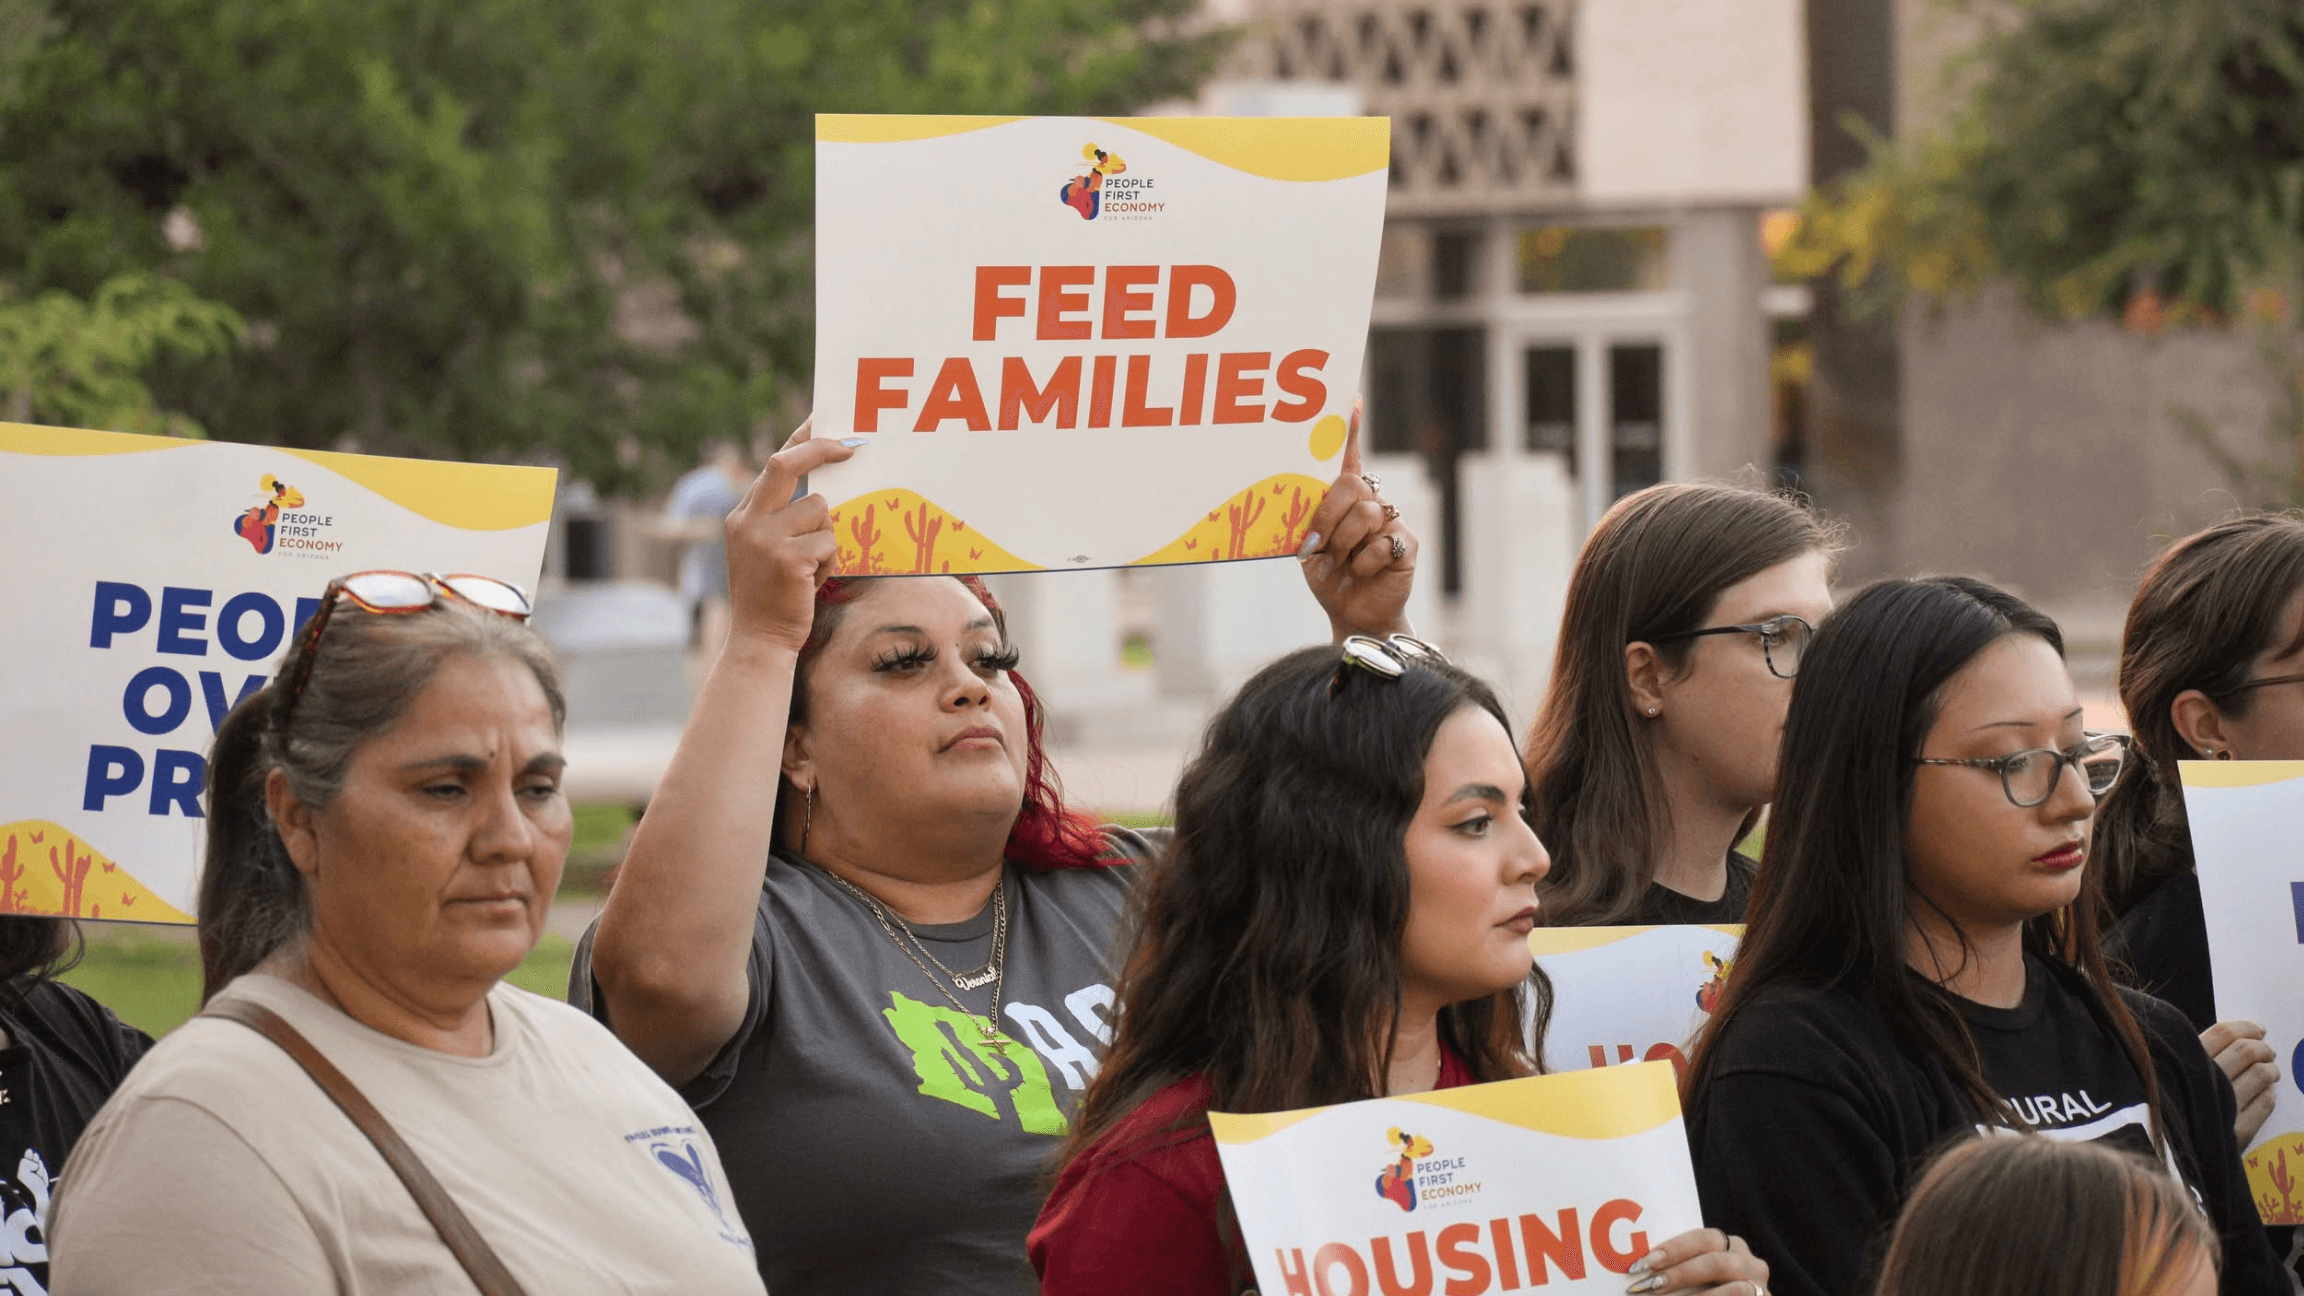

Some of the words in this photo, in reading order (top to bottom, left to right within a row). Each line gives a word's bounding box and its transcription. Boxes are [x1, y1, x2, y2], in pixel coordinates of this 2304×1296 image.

[1106, 179, 1153, 188] PEOPLE
[1105, 191, 1140, 200] FIRST
[1105, 203, 1165, 212] ECONOMY
[972, 264, 1237, 342] FEED
[853, 348, 1331, 433] FAMILIES
[282, 513, 332, 526] PEOPLE
[281, 526, 317, 537] FIRST
[280, 538, 342, 552] ECONOMY
[122, 666, 278, 738] OV
[1417, 1157, 1466, 1173] PEOPLE
[1419, 1173, 1453, 1187] FIRST
[1421, 1182, 1481, 1200] ECONOMY
[1274, 1198, 1650, 1296] HOUSING
